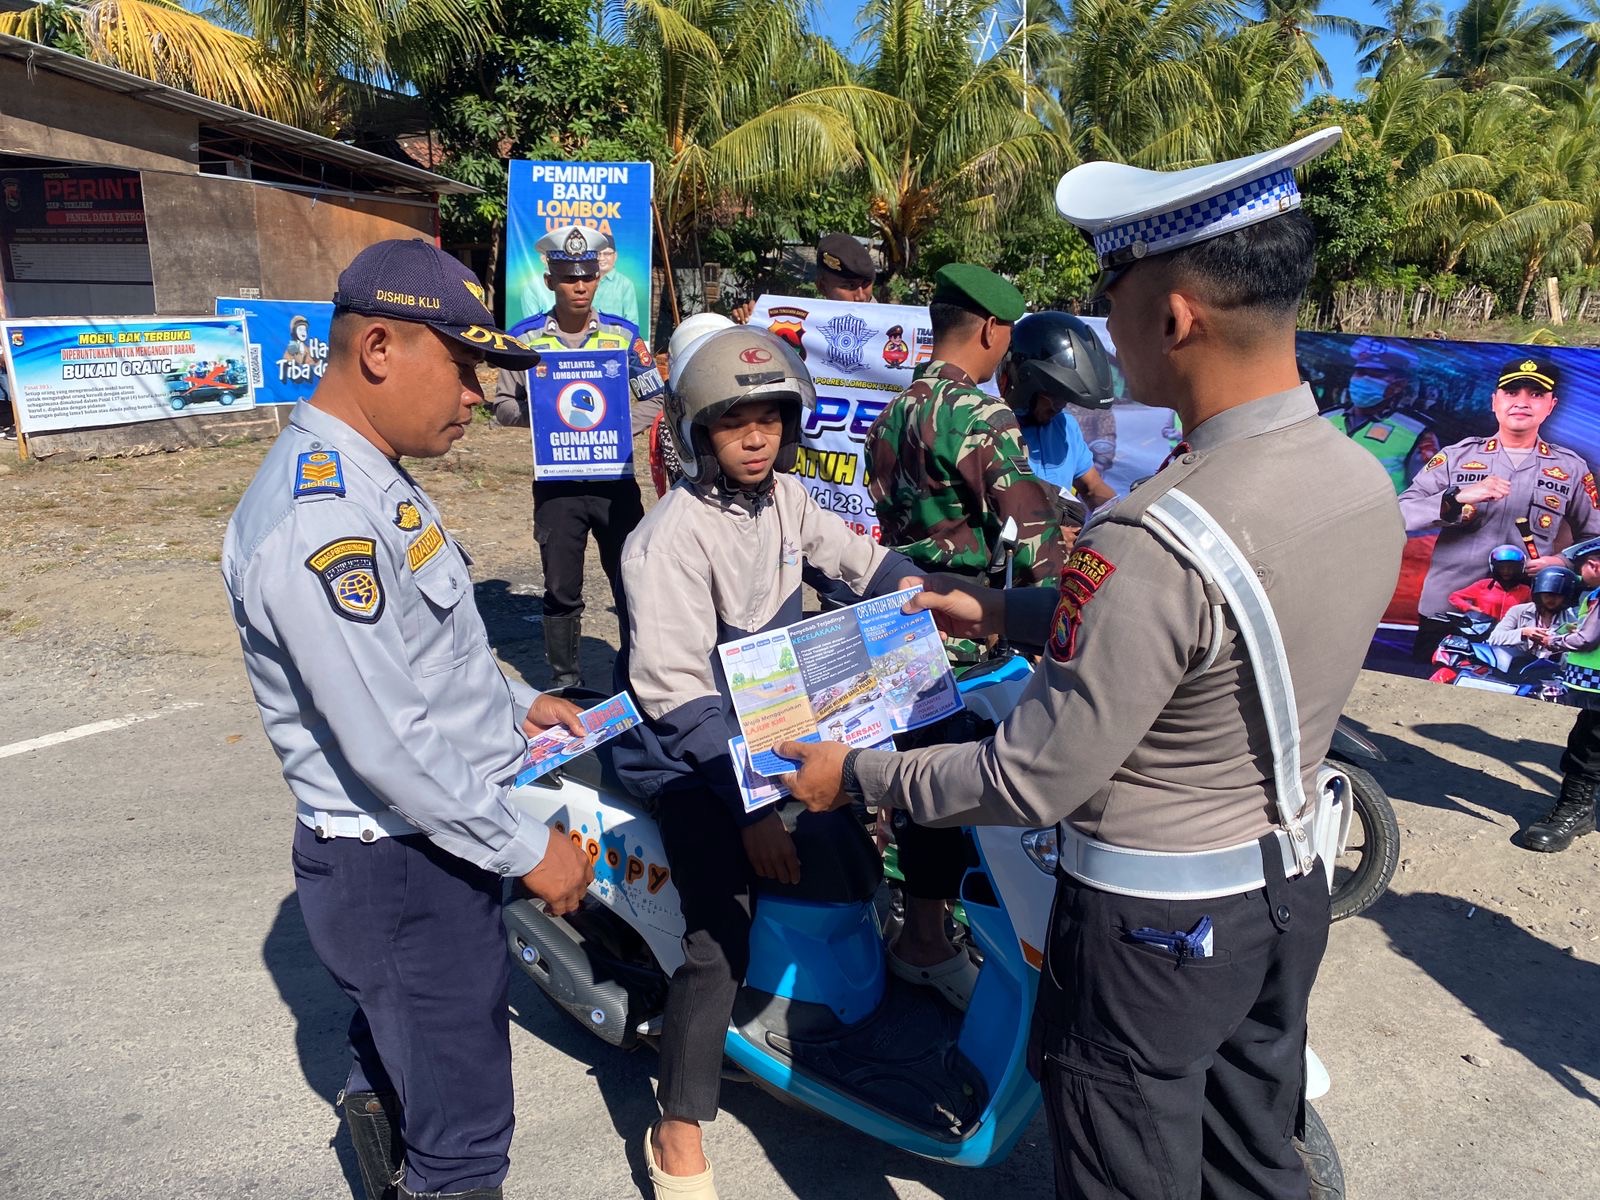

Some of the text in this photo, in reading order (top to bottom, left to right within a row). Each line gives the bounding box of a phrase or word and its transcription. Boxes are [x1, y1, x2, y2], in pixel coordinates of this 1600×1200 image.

[532, 165, 628, 184] PEMIMPIN
[552, 183, 607, 200] BARU
[537, 200, 622, 219] LOMBOK
[376, 289, 440, 309] DISHUB KLU
[79, 331, 192, 345] MOBIL BAK TERBUKA
[174, 344, 196, 355] BARANG
[309, 338, 329, 359] Ha
[62, 359, 172, 380] BUKAN ORANG
[276, 359, 310, 380] Tiba
[558, 360, 596, 370] SATLANTAS
[553, 370, 603, 380] LOMBOK UTARA
[815, 377, 845, 387] POLRES
[845, 379, 878, 390] LOMBOK
[550, 430, 619, 447] GUNAKAN
[553, 445, 618, 461] HELM SNI
[300, 480, 341, 489] DISHUB
[1537, 479, 1570, 496] POLRI
[833, 490, 863, 515] 28
[791, 624, 842, 646] KECELAKAAN
[845, 721, 882, 742] BERSATU
